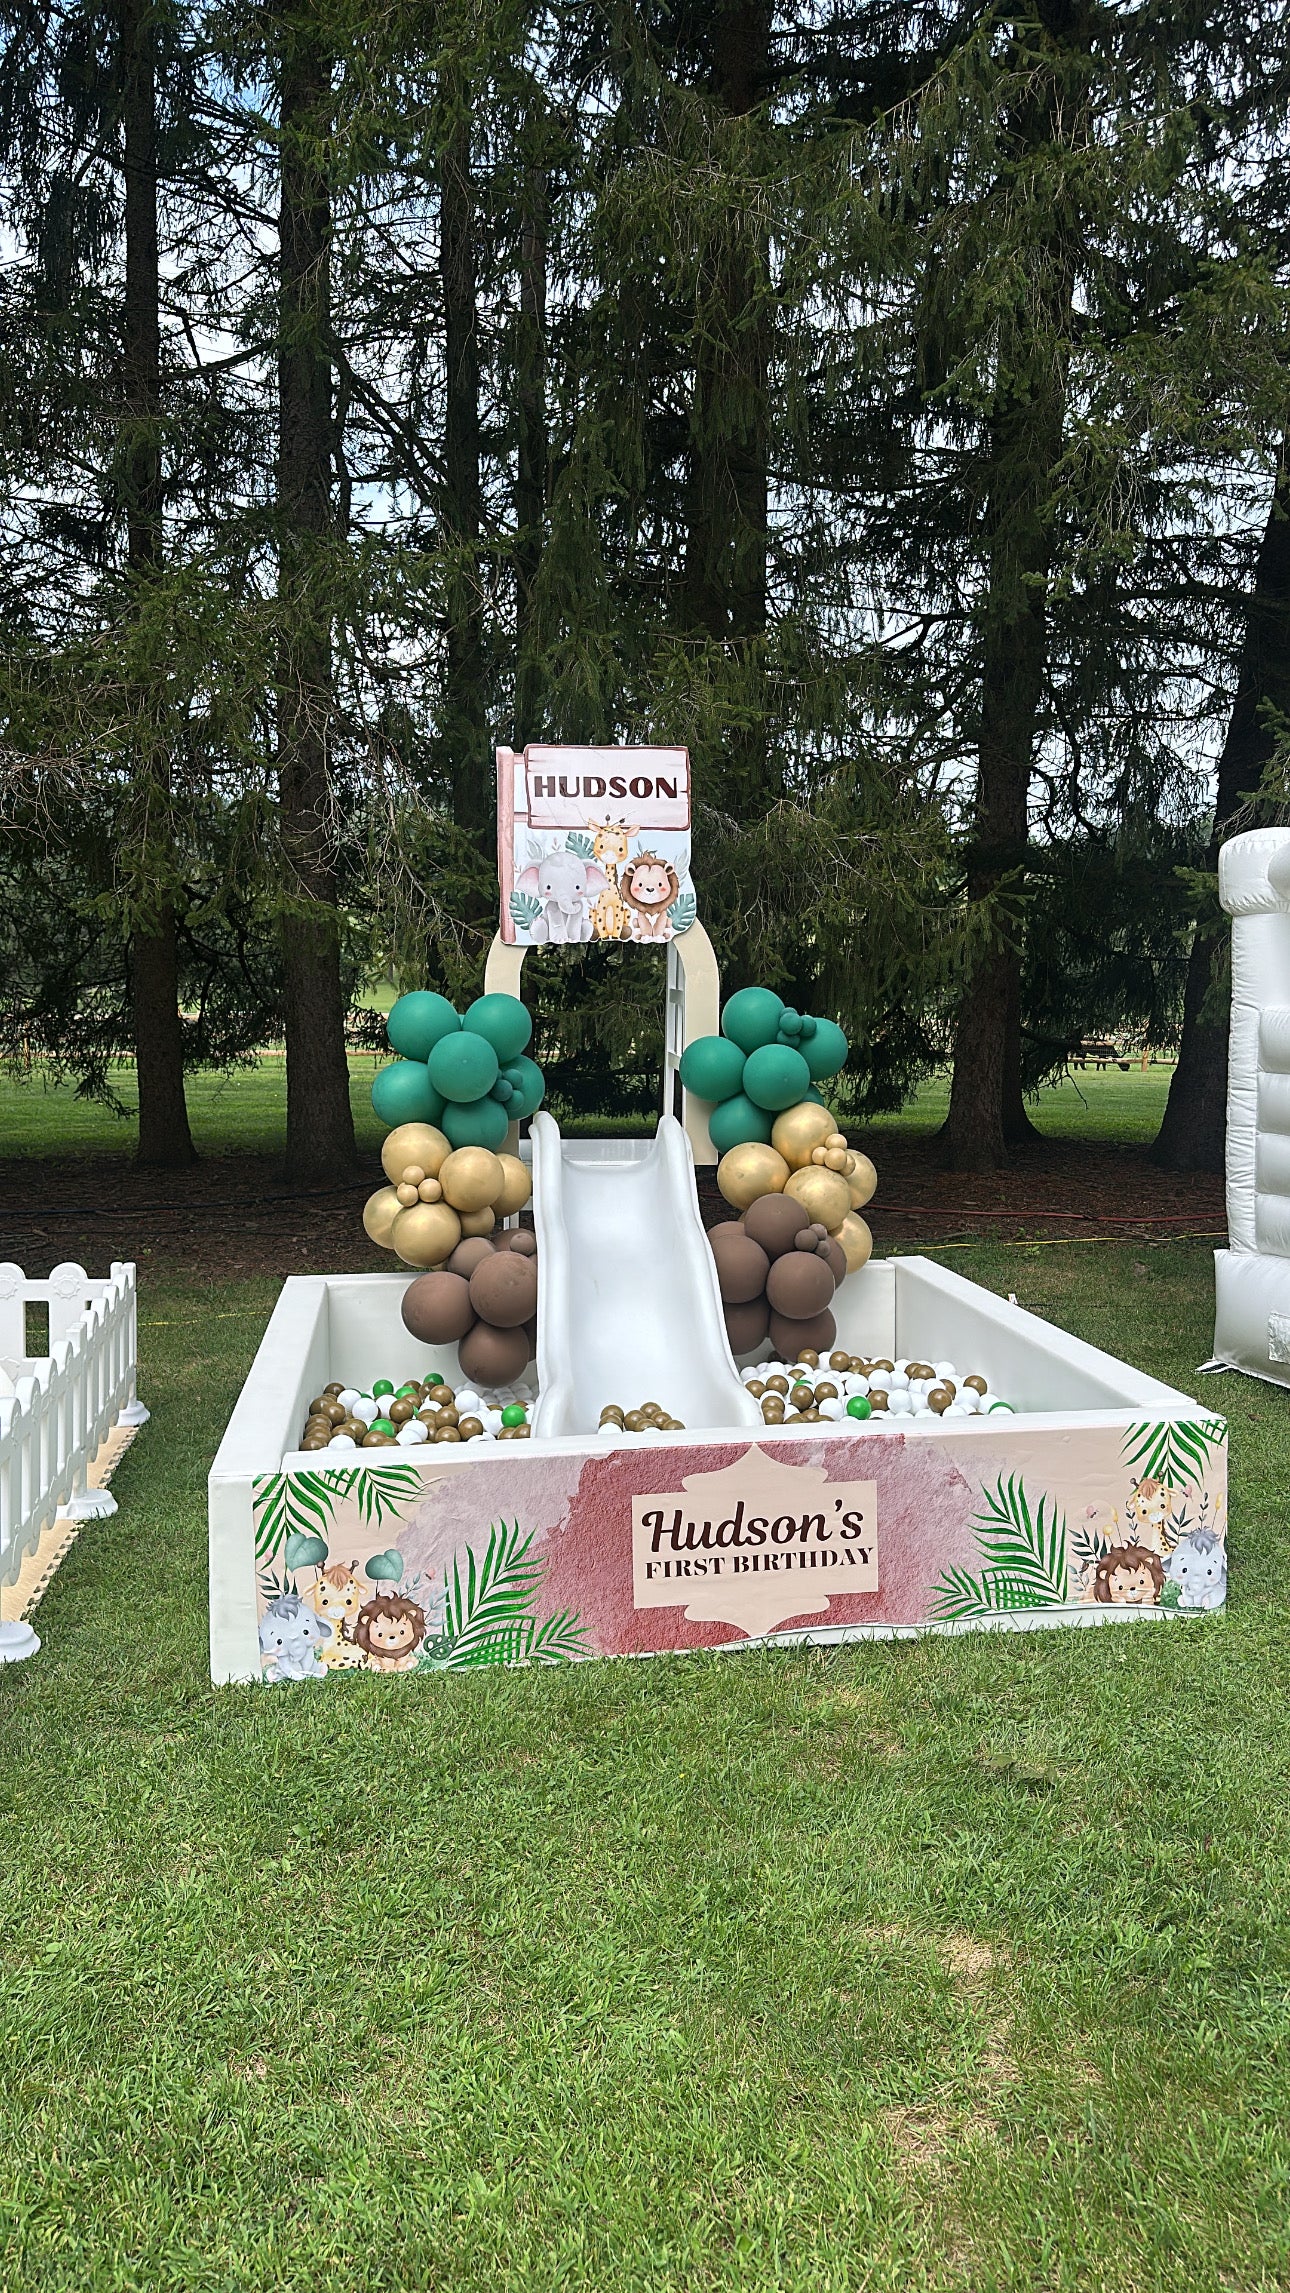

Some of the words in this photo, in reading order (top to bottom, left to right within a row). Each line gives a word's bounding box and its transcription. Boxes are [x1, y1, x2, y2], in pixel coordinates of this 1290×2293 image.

[534, 776, 677, 798] HUDSON
[641, 1499, 863, 1552] Hudson’s
[645, 1556, 725, 1580] FIRST
[733, 1547, 874, 1573] BIRTHDAY
